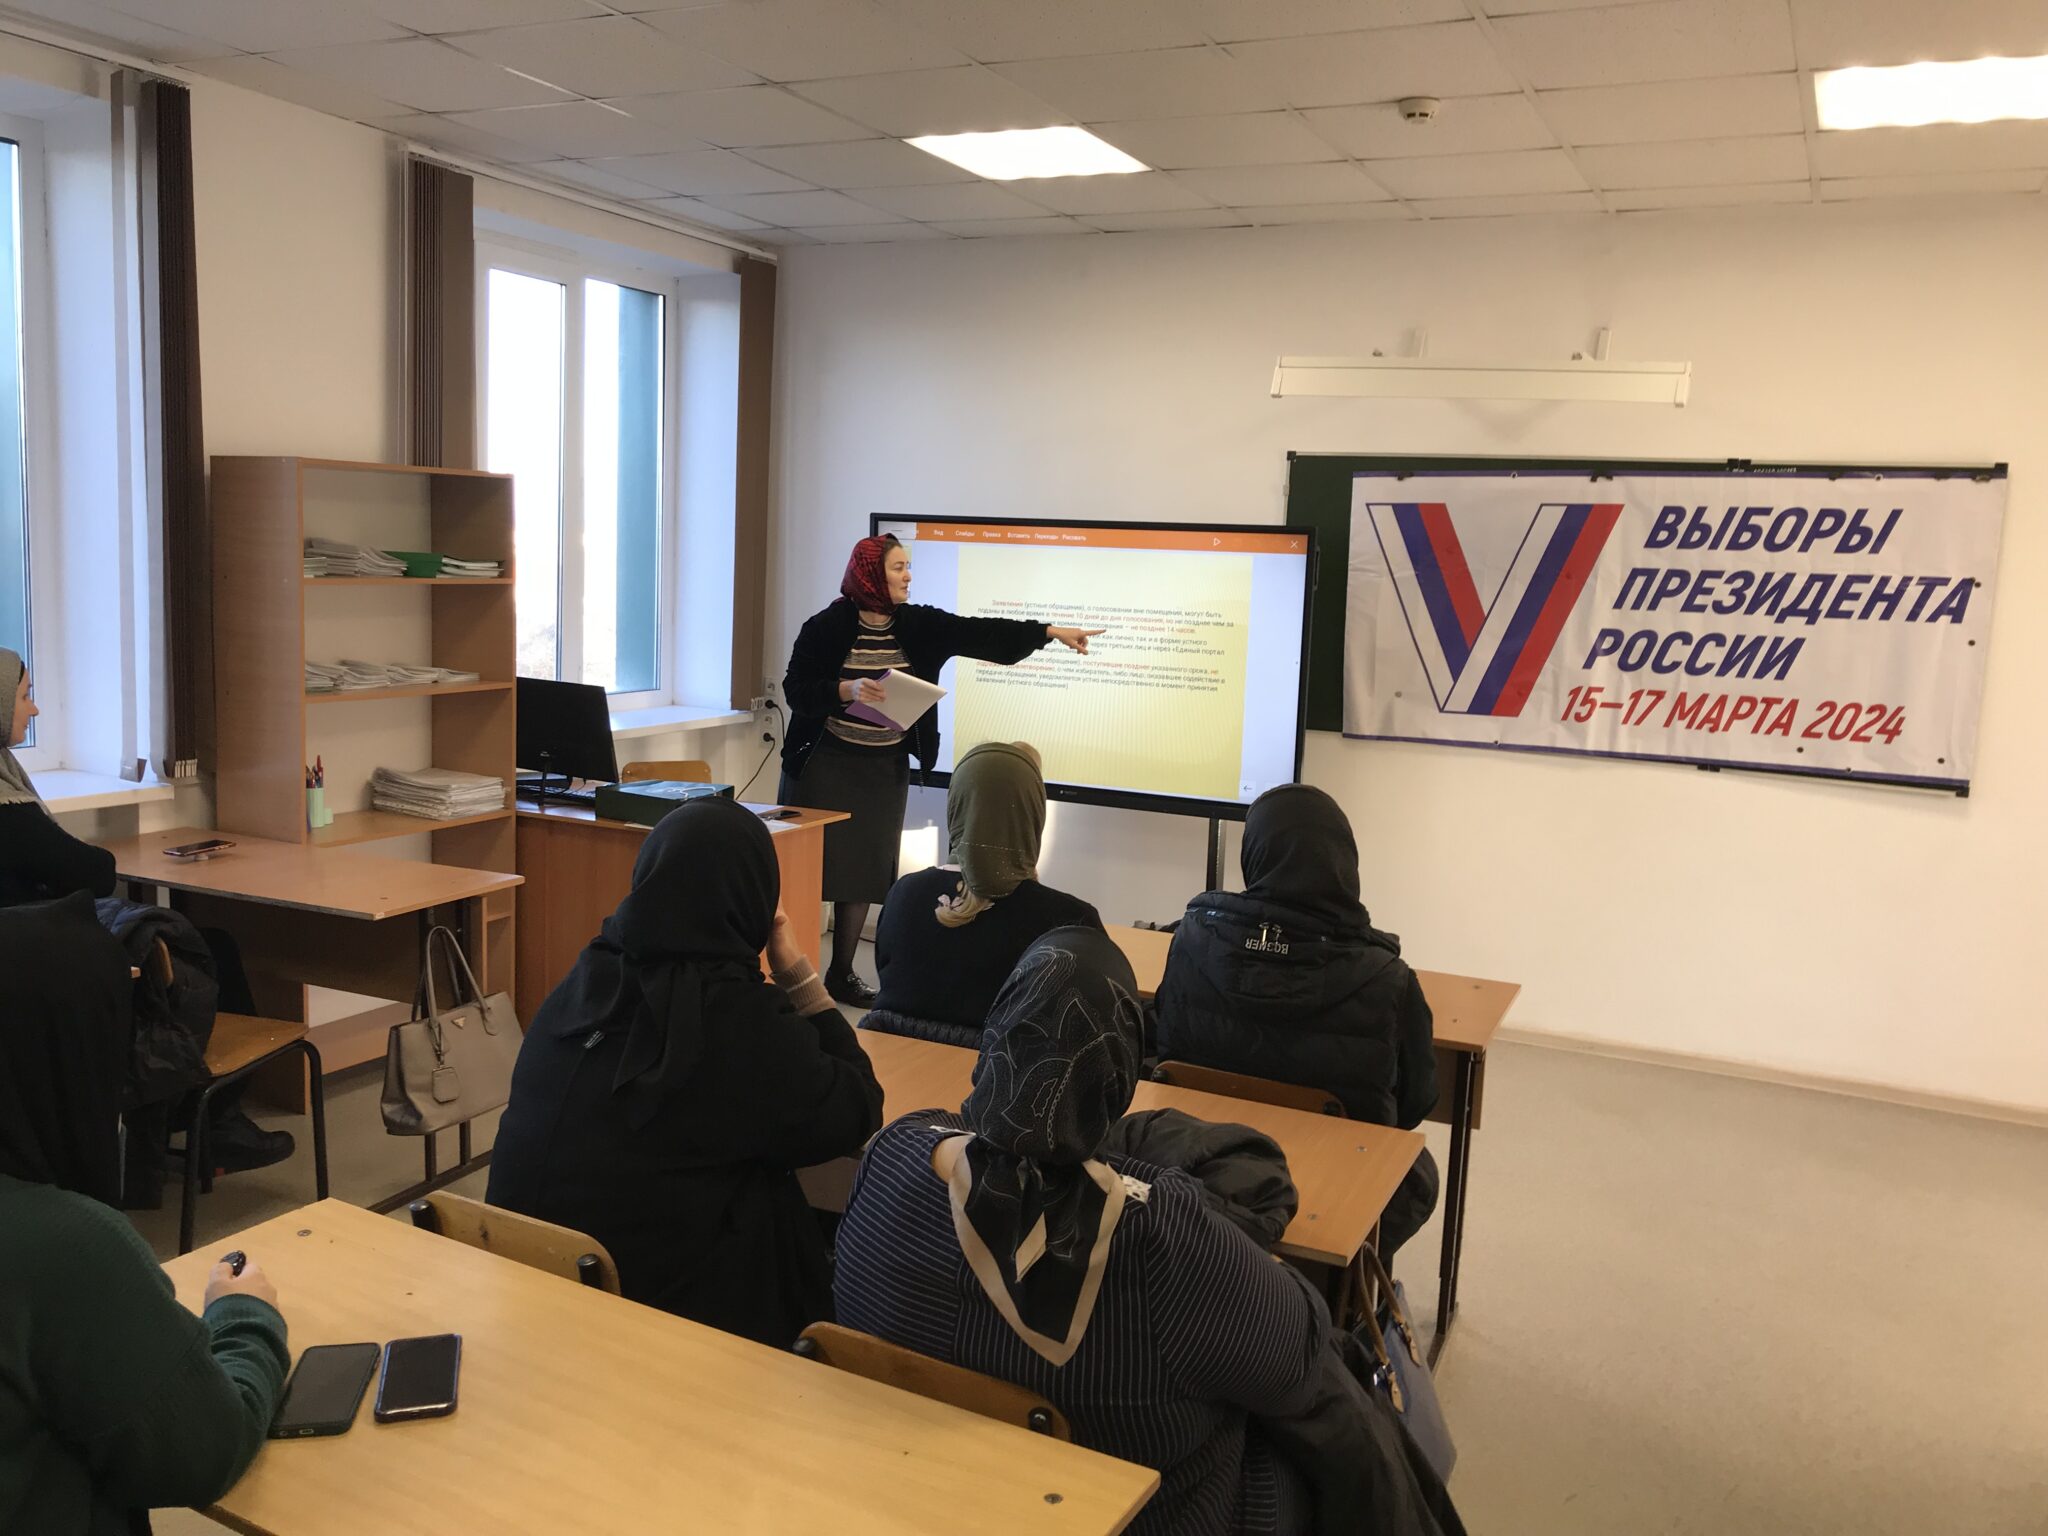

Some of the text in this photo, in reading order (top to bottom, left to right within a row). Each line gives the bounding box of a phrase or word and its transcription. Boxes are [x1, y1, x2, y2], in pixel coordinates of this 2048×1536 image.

[1644, 507, 1903, 554] ВЫБОРЫ
[1614, 568, 1972, 625] ПРЕЗИДЕНТА
[1084, 612, 1099, 620] дней
[1183, 619, 1210, 627] позднее
[1205, 610, 1221, 618] быть
[1159, 636, 1180, 644] форме
[1583, 629, 1805, 680] РОССИИ
[1150, 665, 1187, 673] указанного
[1100, 678, 1154, 687] непосредственно
[1186, 684, 1217, 692] принятия
[1182, 673, 1219, 683] содействие
[1663, 691, 1800, 737] МАРТА
[1800, 700, 1905, 745] 2024
[1245, 938, 1289, 955] BOGNER
